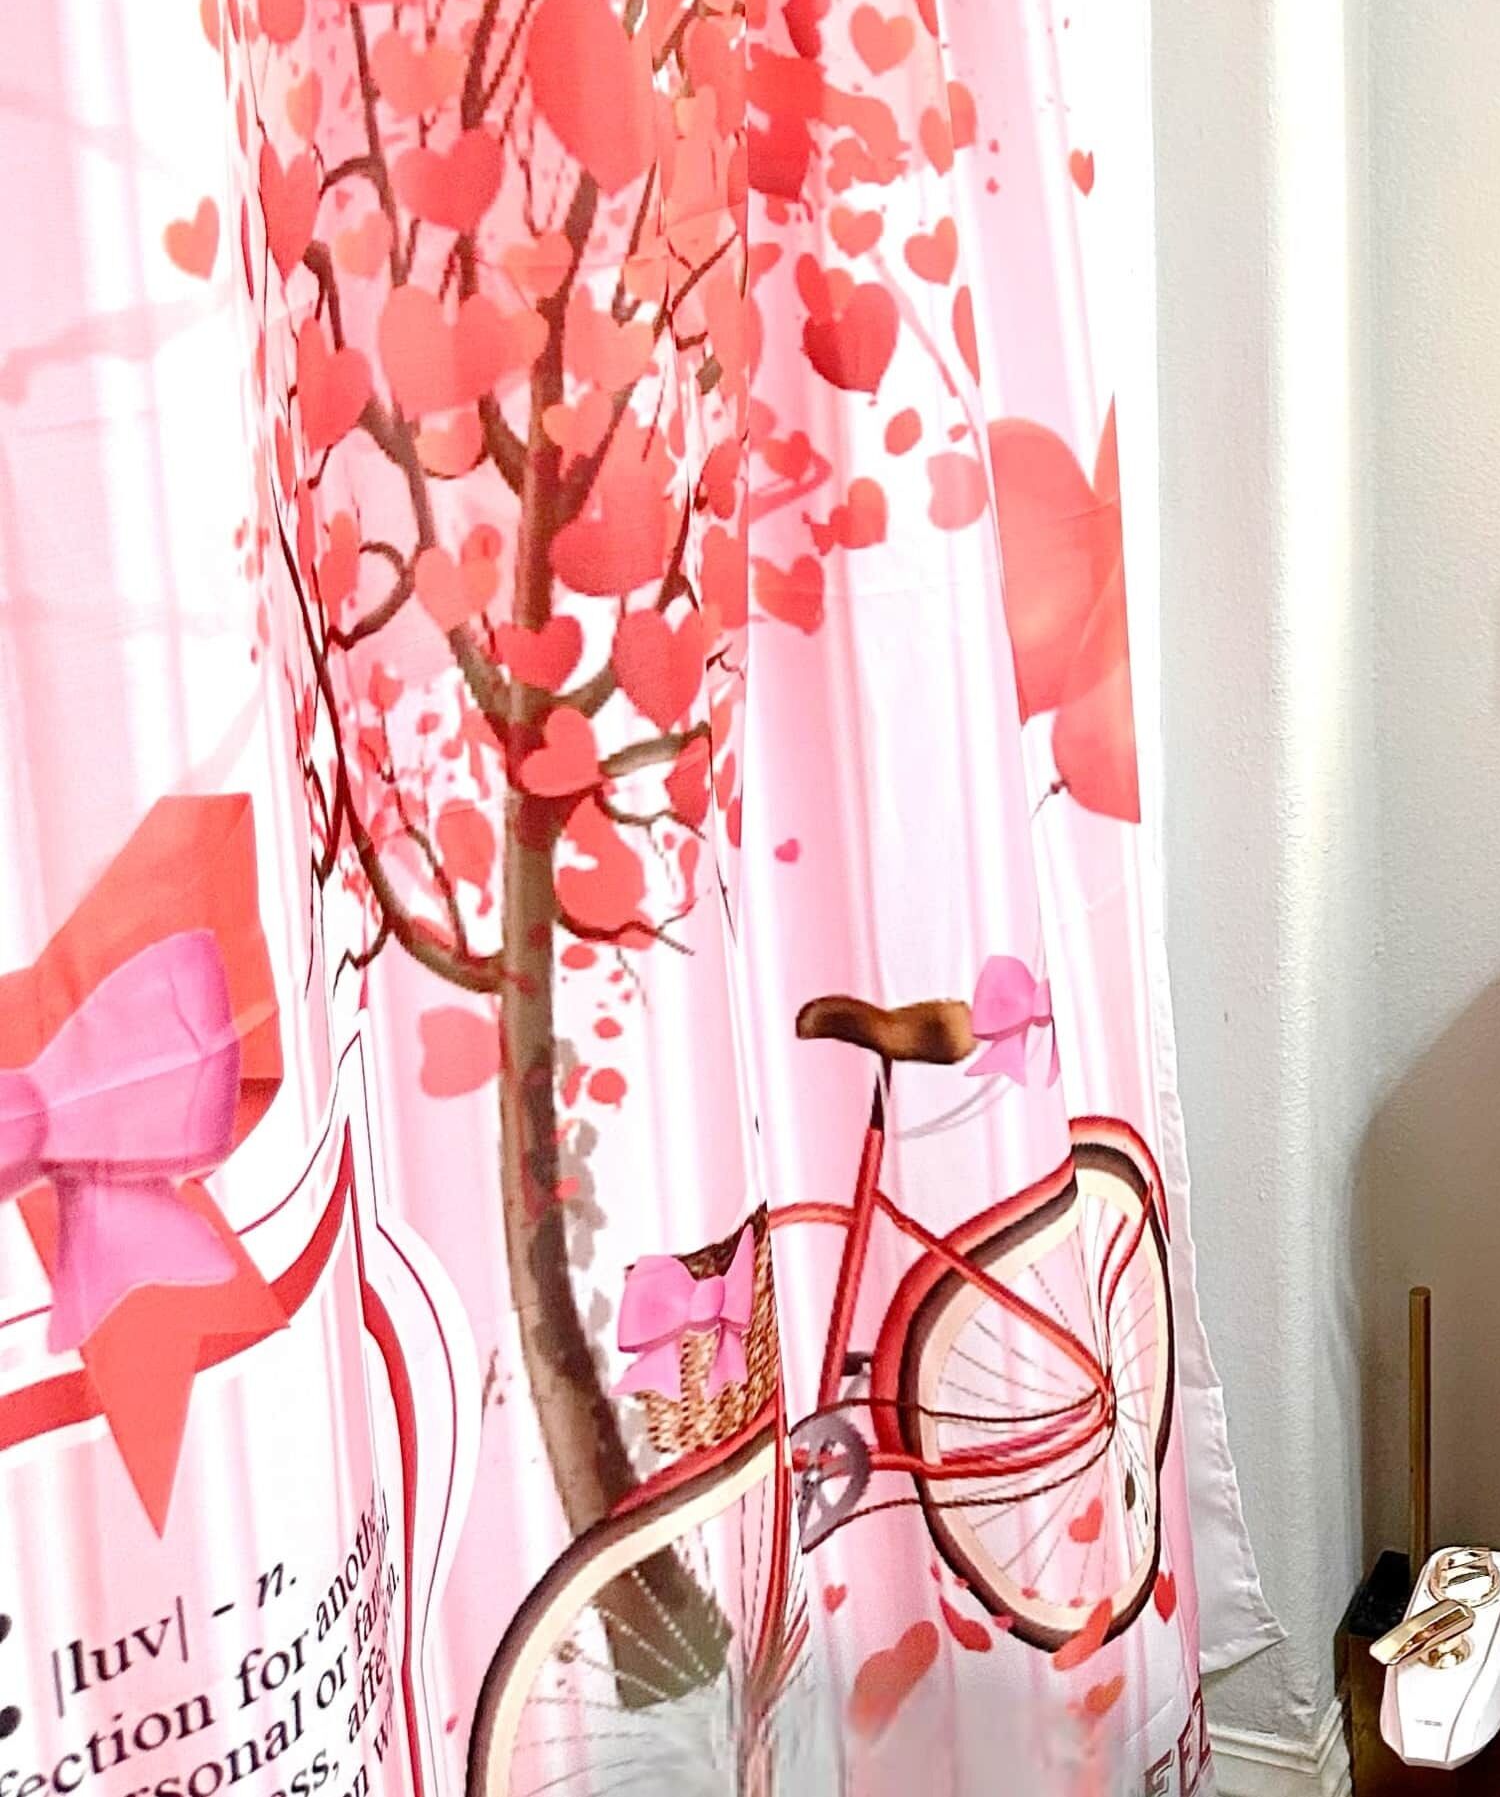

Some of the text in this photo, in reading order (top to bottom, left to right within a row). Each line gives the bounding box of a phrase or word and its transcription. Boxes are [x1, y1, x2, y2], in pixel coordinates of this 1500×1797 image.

[256, 1562, 298, 1608] n.
[235, 1629, 309, 1711] for
[316, 1644, 348, 1710] or
